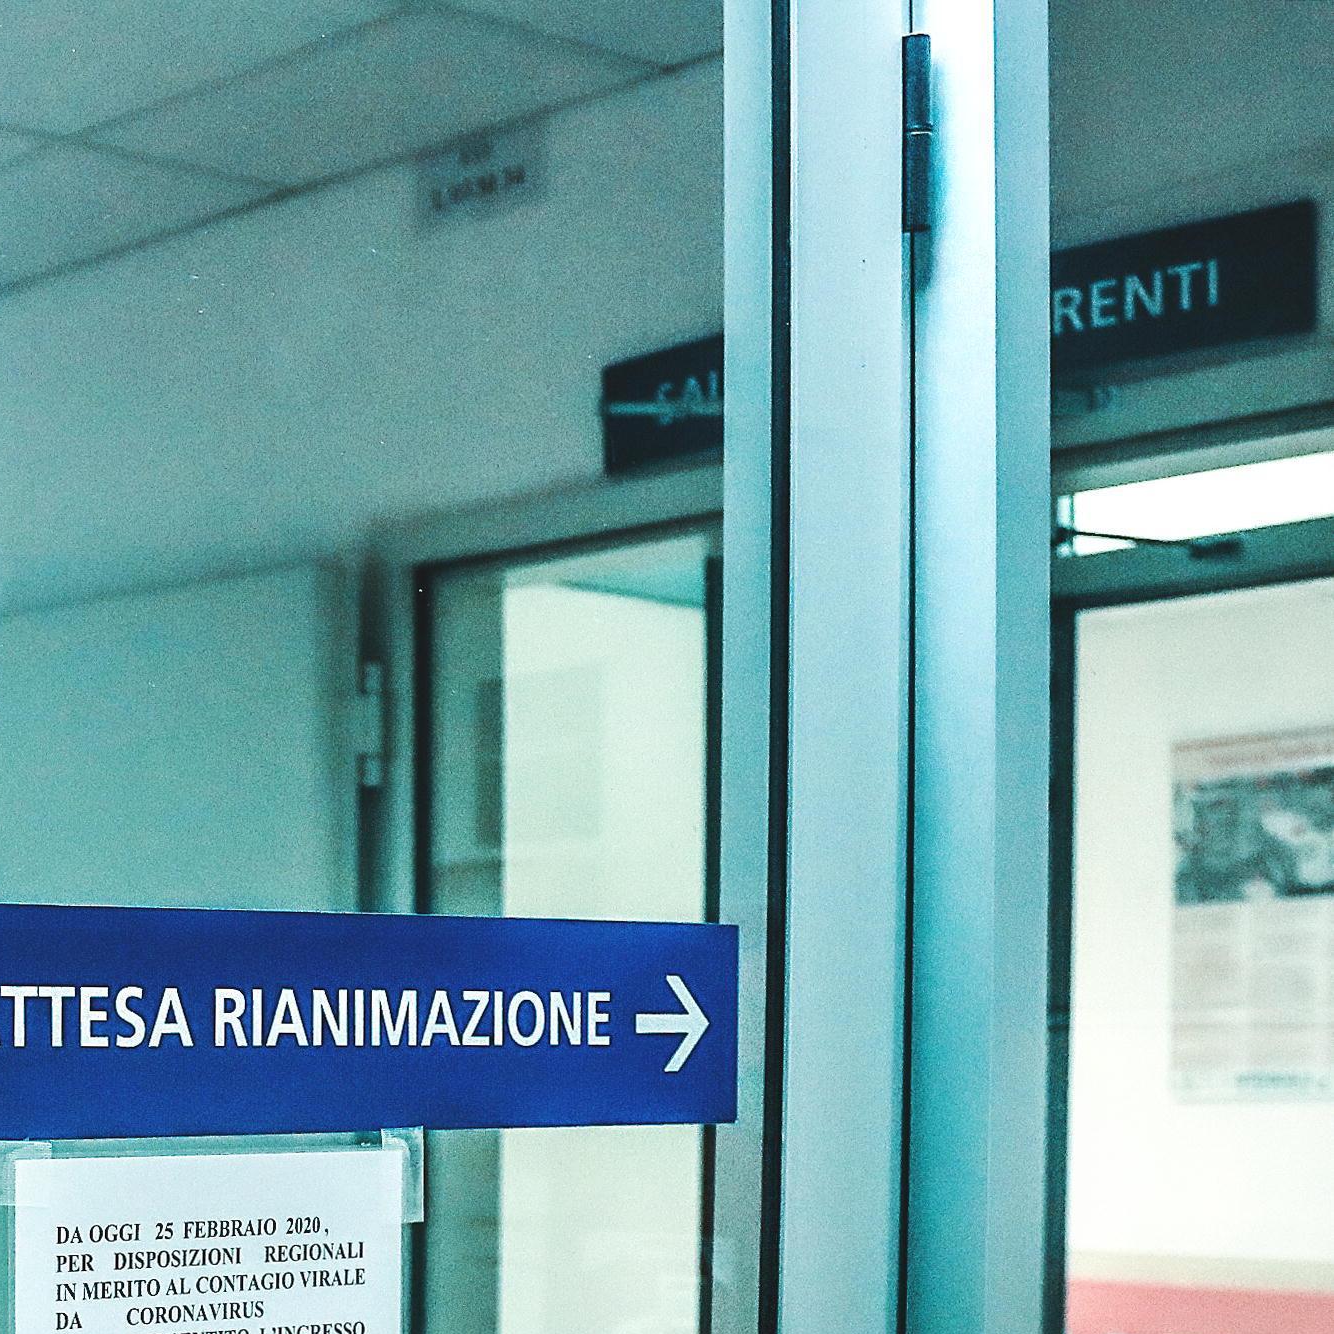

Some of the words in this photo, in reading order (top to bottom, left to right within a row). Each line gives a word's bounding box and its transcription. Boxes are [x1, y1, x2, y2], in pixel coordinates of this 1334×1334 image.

[1052, 258, 1218, 335] RENTI
[213, 987, 611, 1047] RIANIMAZIONE
[56, 1226, 84, 1245] DA
[89, 1223, 141, 1244] OGGI
[155, 1221, 174, 1241] 25
[183, 1217, 277, 1240] FEBBRAIO
[55, 1253, 95, 1274] PER
[113, 1247, 242, 1271] DISPOSIZIONI
[264, 1241, 364, 1264] REGIONALI
[55, 1282, 77, 1302] IN
[82, 1278, 161, 1301] MERITO
[165, 1277, 192, 1296] AL
[195, 1271, 295, 1295] CONTAGIO
[299, 1267, 366, 1288] VIRALE
[55, 1311, 83, 1331] DA
[126, 1300, 265, 1326] CORONAVIRUS
